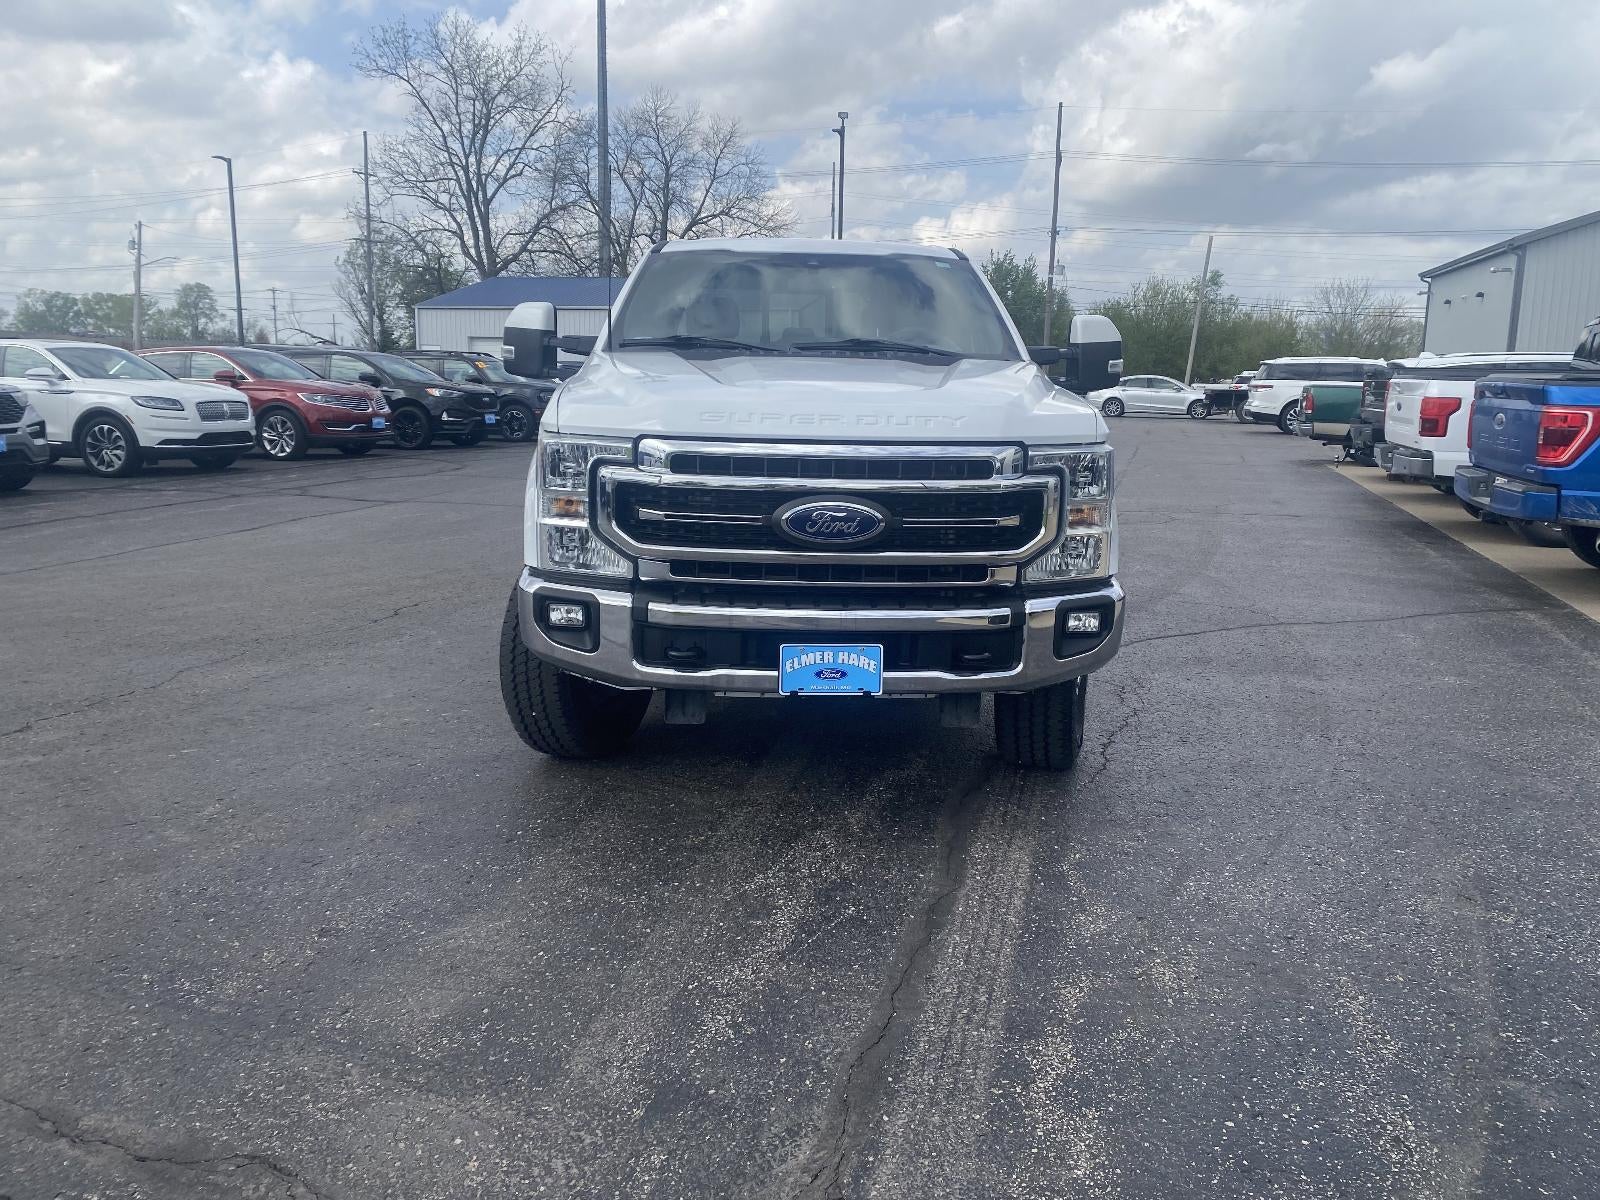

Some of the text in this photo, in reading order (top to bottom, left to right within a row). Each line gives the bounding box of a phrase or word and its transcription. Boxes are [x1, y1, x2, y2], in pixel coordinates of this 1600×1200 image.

[699, 410, 968, 429] SUPER DUTY
[805, 510, 861, 534] Ford
[785, 651, 878, 674] ELMER HARE
[820, 669, 842, 678] Ford
